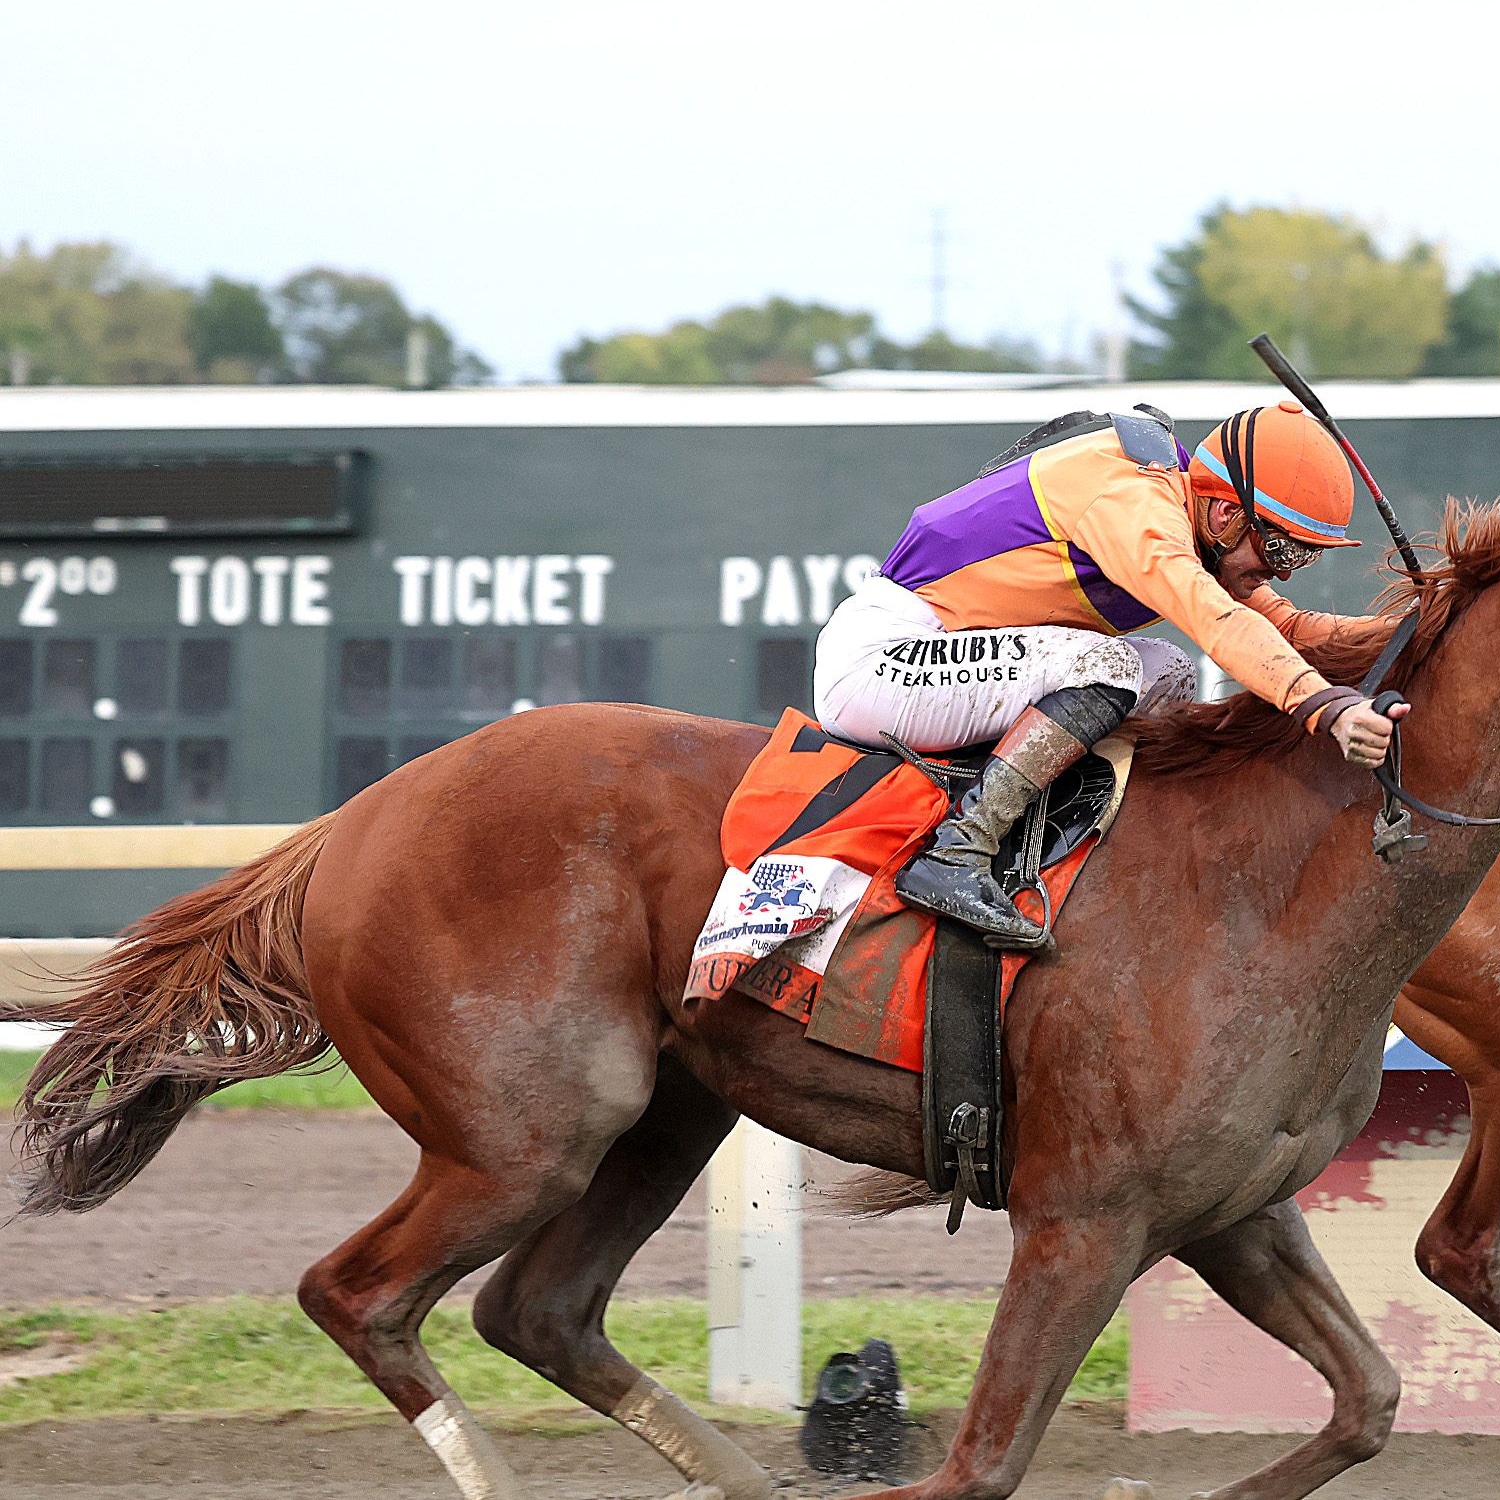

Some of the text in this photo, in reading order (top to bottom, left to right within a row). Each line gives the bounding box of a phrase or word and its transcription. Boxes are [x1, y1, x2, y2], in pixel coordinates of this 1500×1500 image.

[170, 556, 333, 627] TOTE
[392, 554, 614, 627] TICKET
[930, 634, 1027, 665] RUBY'S
[875, 663, 1018, 687] STEAKHOUSE
